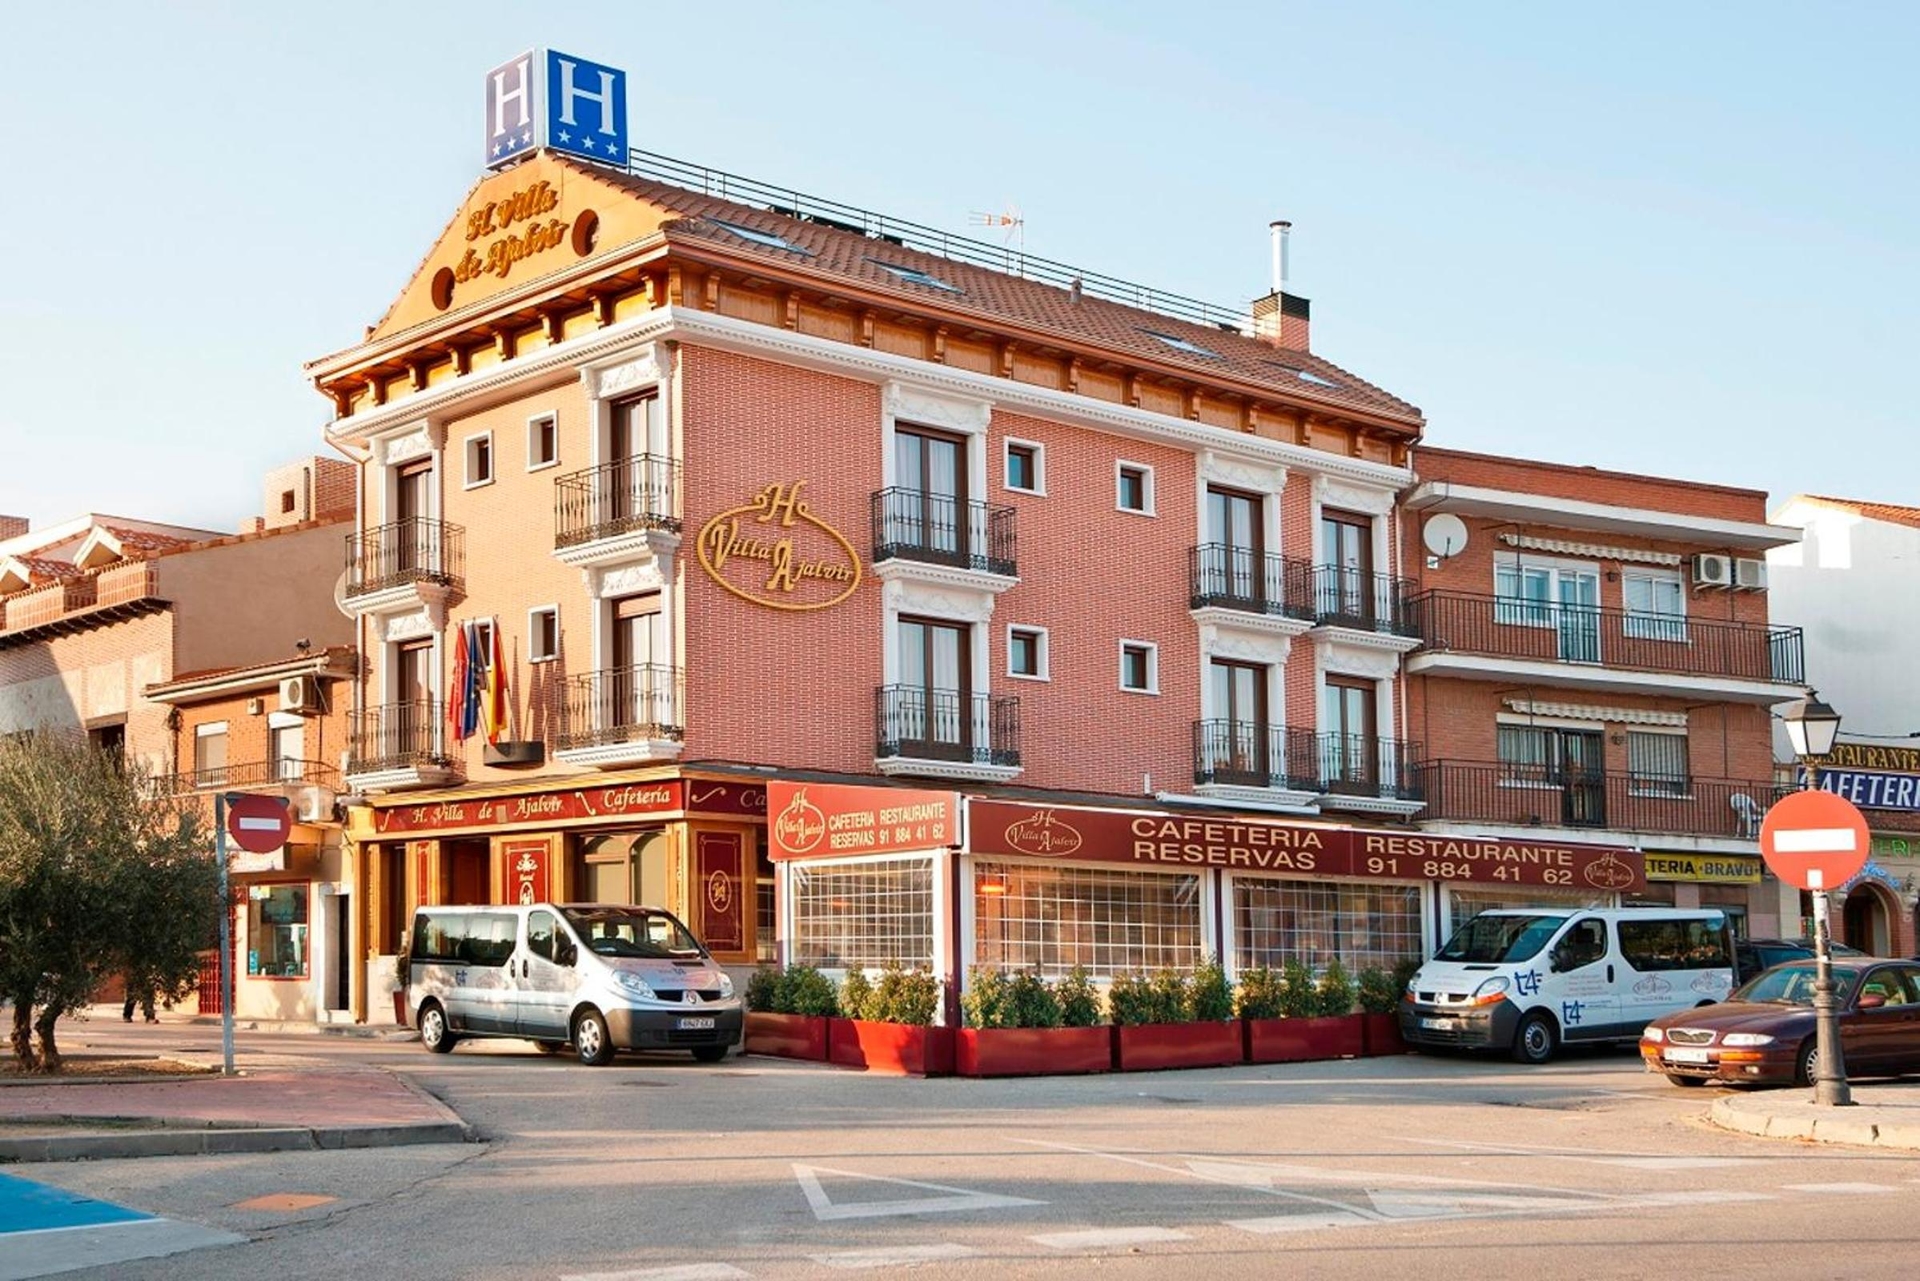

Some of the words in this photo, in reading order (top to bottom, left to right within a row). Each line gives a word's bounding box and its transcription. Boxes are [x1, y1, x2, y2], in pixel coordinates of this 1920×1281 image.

[493, 58, 531, 137] H
[558, 58, 617, 136] H
[497, 180, 558, 229] Villa
[456, 248, 482, 283] de
[757, 480, 807, 526] H
[710, 518, 771, 569] Villa
[766, 537, 853, 591] Ajalvir
[1803, 745, 1920, 771] STAURANTE
[433, 802, 465, 823] Villa
[478, 802, 492, 820] de
[513, 794, 563, 819] Ajalvir
[828, 811, 875, 831] CAFETERIA
[881, 802, 945, 825] RESTAURANTE
[830, 830, 875, 849] RESERVAS
[880, 828, 889, 845] 91
[895, 826, 911, 843] 884
[916, 824, 926, 840] 41
[932, 822, 944, 839] 62
[1131, 818, 1323, 849] CAFETERIA
[1366, 836, 1574, 866] RESTAURANTE
[1134, 841, 1315, 870] RESERVAS
[1367, 857, 1398, 875] 91
[1423, 861, 1472, 878] 884
[1493, 866, 1521, 881] 41
[1543, 869, 1573, 885] 62
[1645, 859, 1695, 875] TERIA
